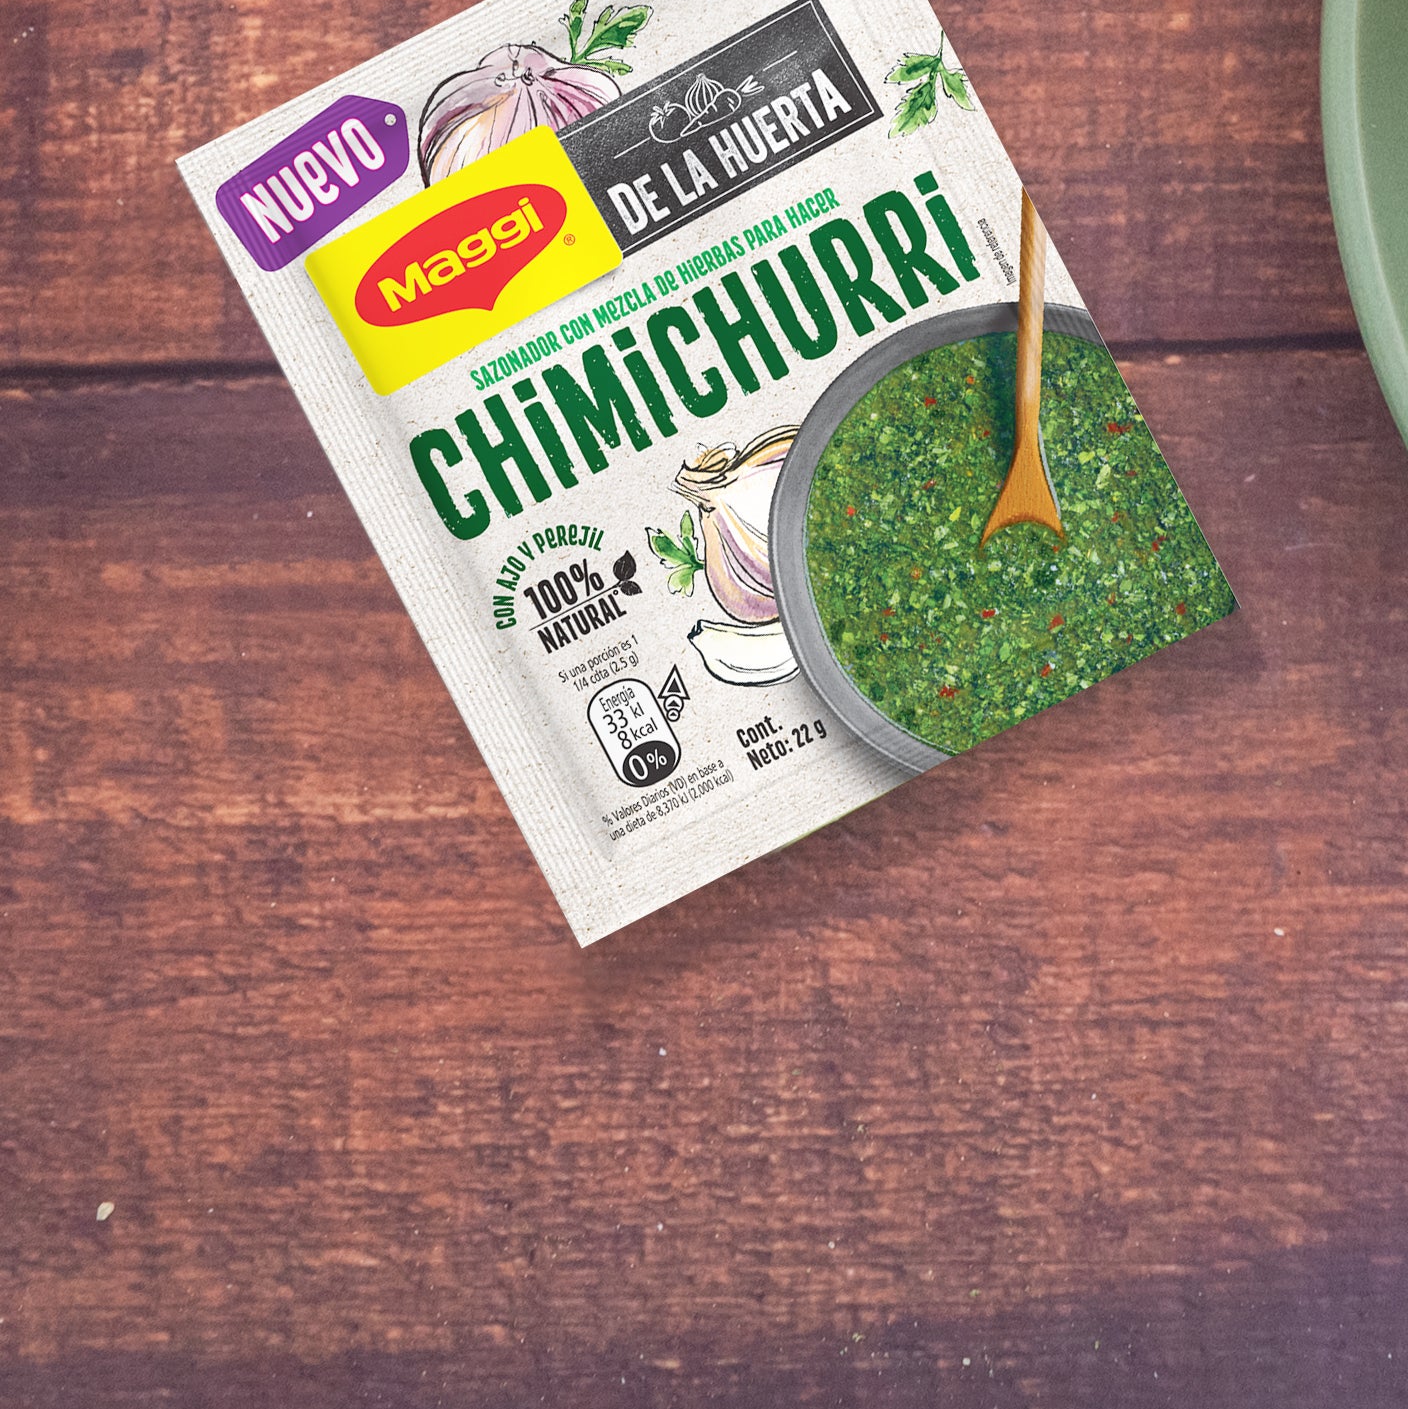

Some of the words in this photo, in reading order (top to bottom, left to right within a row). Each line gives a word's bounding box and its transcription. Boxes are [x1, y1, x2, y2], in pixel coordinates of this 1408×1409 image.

[607, 173, 671, 235] DE
[660, 149, 719, 206] LA
[707, 68, 852, 179] HUERTA
[977, 218, 1000, 252] referencia
[377, 196, 545, 312] Maggi
[993, 250, 1005, 261] de
[998, 259, 1017, 287] Imagen
[469, 330, 562, 391] SAZONADOR
[559, 312, 591, 343] CON
[742, 215, 788, 251] PARA
[517, 540, 535, 561] Y
[496, 555, 526, 592] AJO
[523, 558, 605, 620] 100%
[493, 595, 517, 630] CON
[558, 670, 569, 684] Si
[569, 663, 587, 678] una
[587, 645, 621, 671] porción
[621, 640, 633, 651] es
[631, 634, 639, 645] 1
[572, 677, 589, 692] 1/4
[589, 667, 611, 684] cdta
[609, 657, 629, 676] (2.5
[627, 651, 640, 666] g)
[599, 685, 636, 712] Energía
[602, 708, 629, 734] 33
[617, 730, 633, 750] 8
[629, 717, 658, 741] kcal
[736, 715, 783, 748] Cont.
[746, 738, 794, 771] Neto:
[791, 723, 815, 747] 22
[813, 719, 828, 738] g
[601, 815, 614, 827] %
[611, 801, 643, 822] Valores
[640, 786, 670, 807] Diarios
[668, 775, 688, 796] (VD)
[686, 771, 700, 783] en
[697, 762, 718, 779] base
[716, 759, 725, 769] a
[609, 827, 627, 841] una
[625, 816, 647, 833] dieta
[645, 809, 657, 823] de
[656, 798, 680, 817] 8,370
[688, 780, 715, 803] (2,000
[713, 769, 735, 789] kcal)
